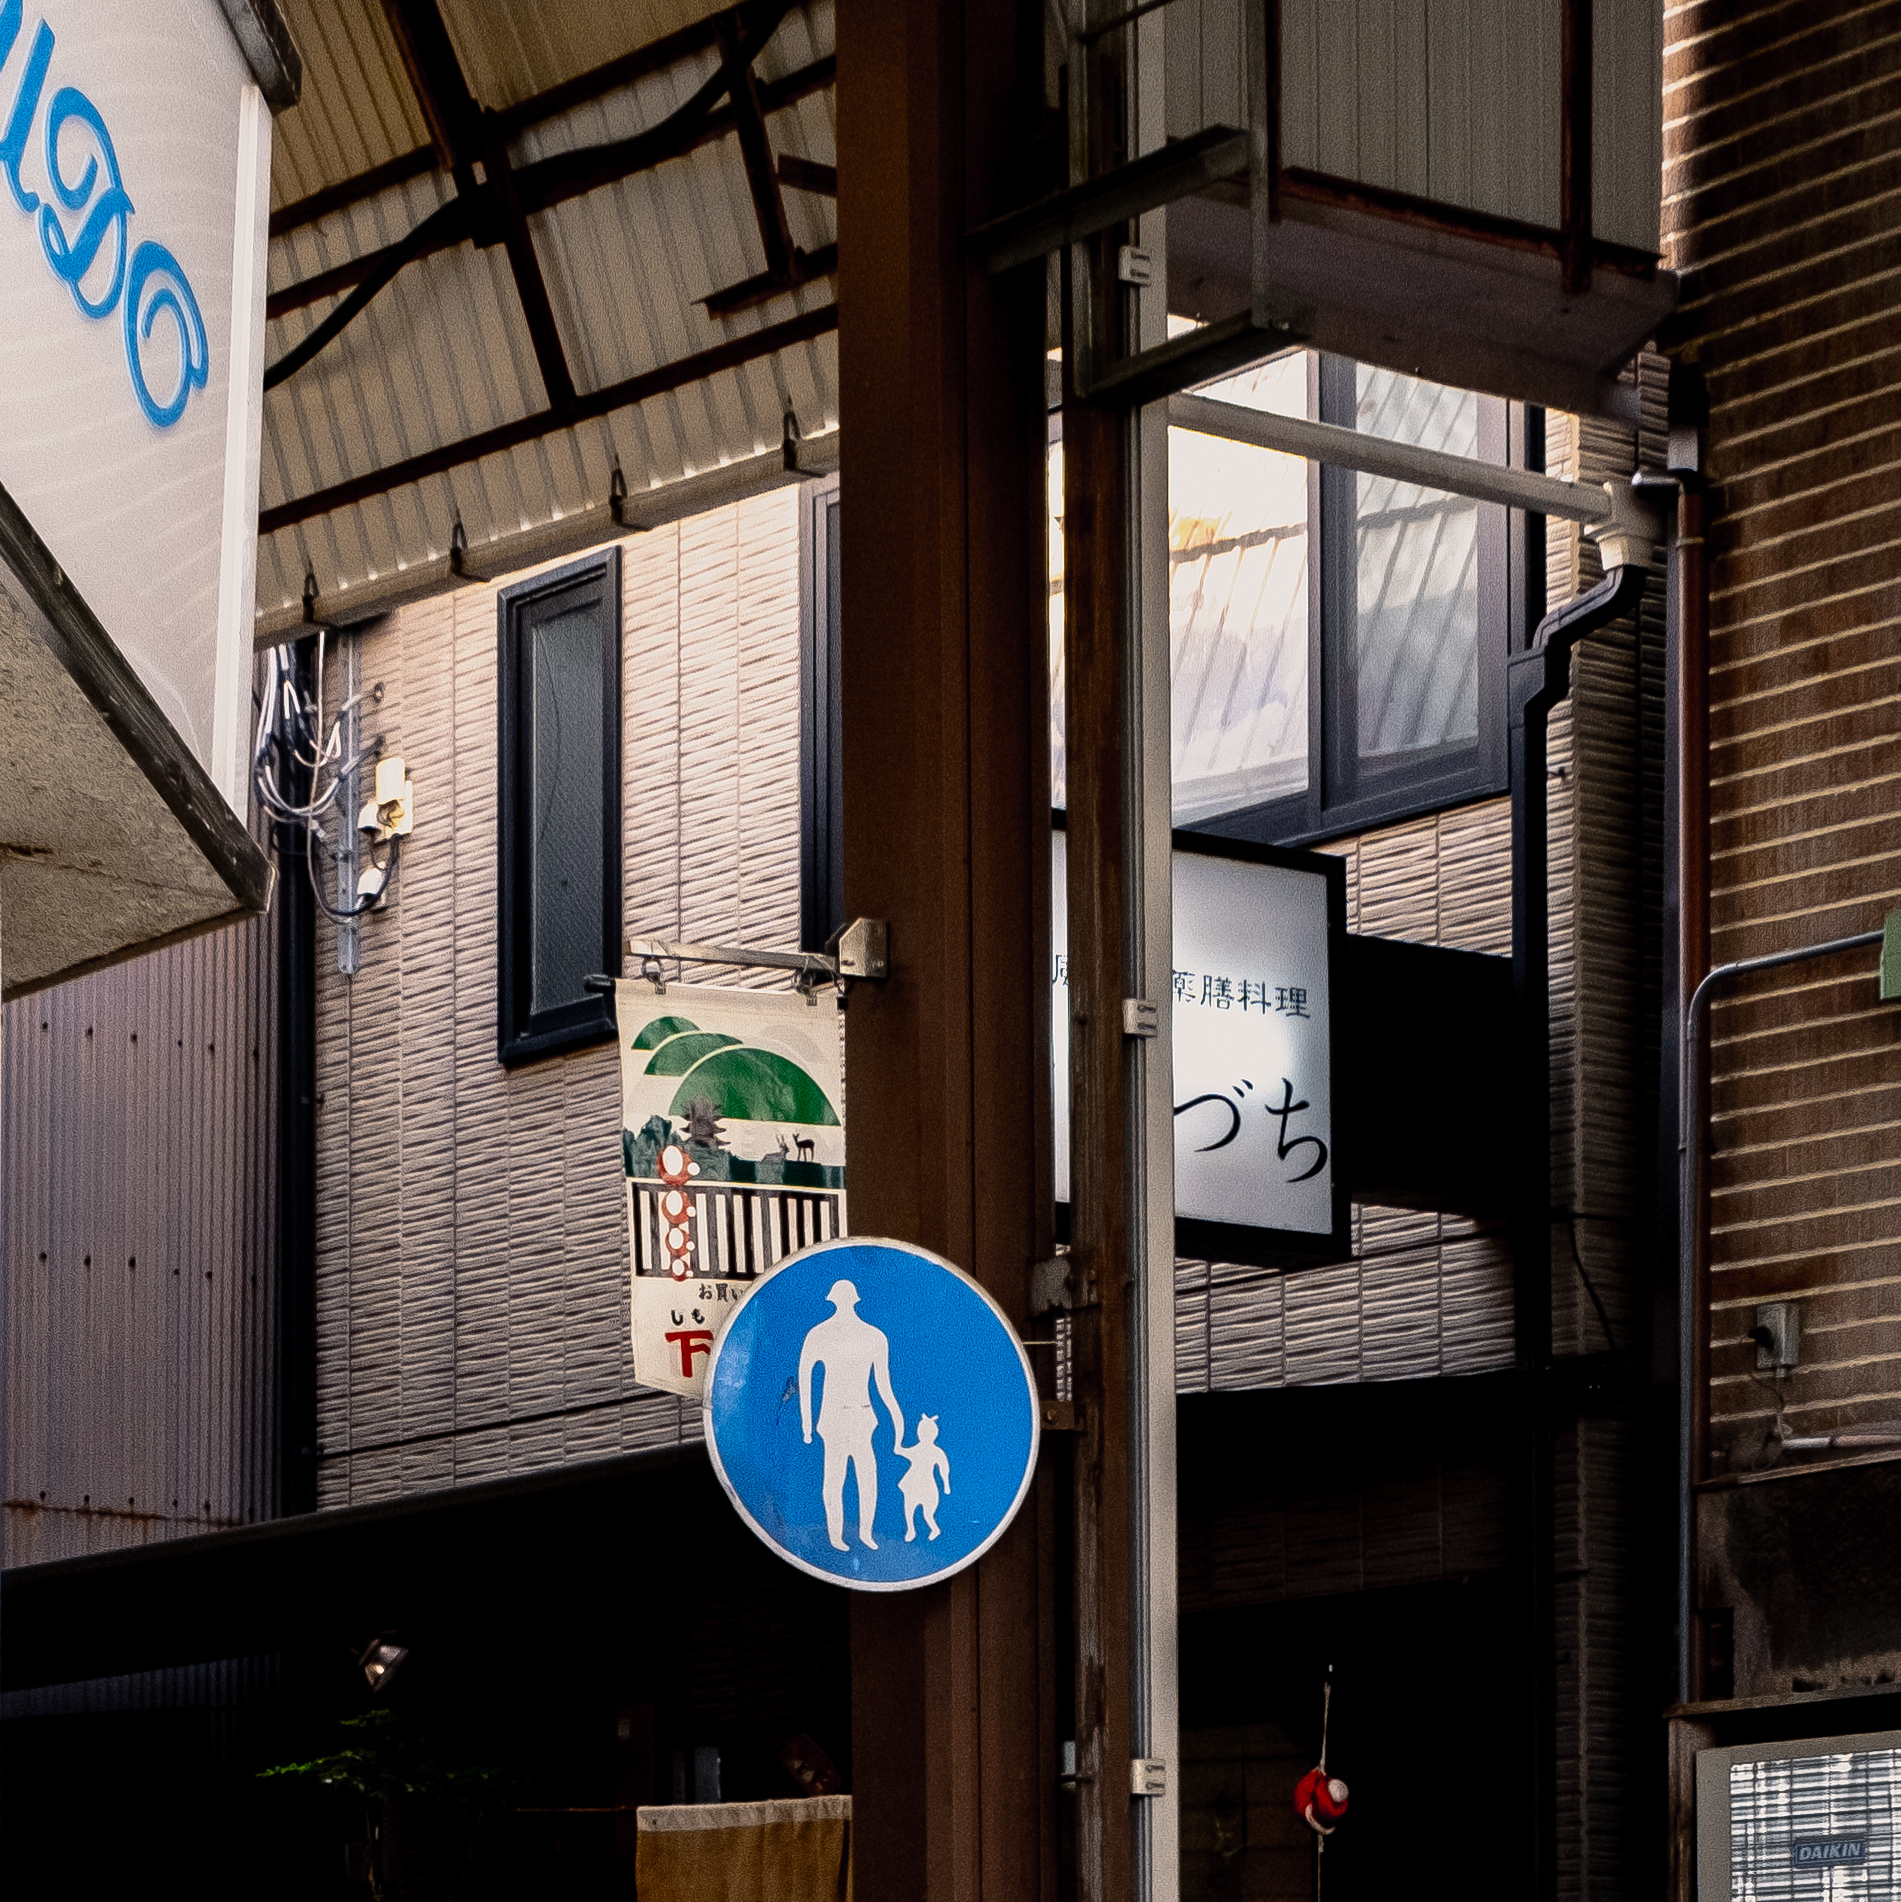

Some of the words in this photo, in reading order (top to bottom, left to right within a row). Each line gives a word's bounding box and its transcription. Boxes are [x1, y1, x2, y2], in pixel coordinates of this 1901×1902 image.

[1173, 1076, 1330, 1184] づち
[670, 1308, 706, 1326] しも
[665, 1330, 714, 1378] 下
[1798, 1842, 1861, 1861] DAIKIN
